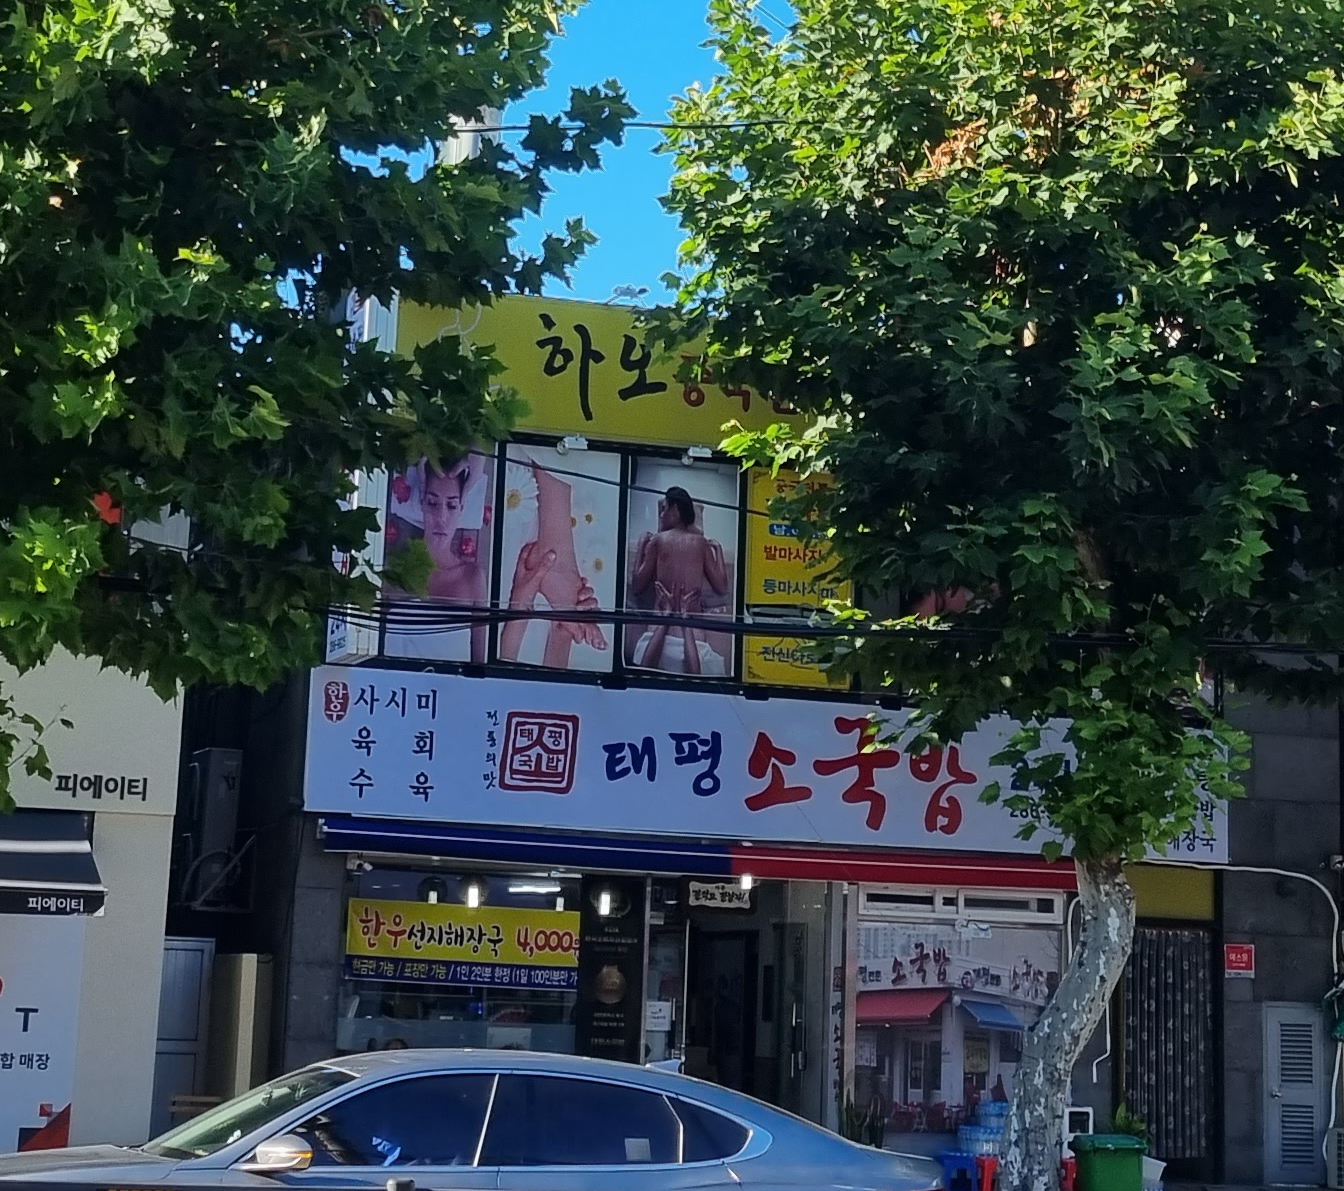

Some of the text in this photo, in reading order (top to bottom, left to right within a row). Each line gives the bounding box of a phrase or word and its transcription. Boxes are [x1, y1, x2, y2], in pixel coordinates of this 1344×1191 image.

[327, 682, 438, 722] 한우 사시미
[55, 773, 149, 802] 피에이티
[603, 730, 722, 797] 태평
[744, 715, 977, 836] 소국밥
[27, 896, 85, 913] 피에이티
[378, 960, 394, 976] 가능
[403, 962, 428, 978] 포장만
[430, 964, 447, 979] 가능
[456, 965, 470, 981] 1인
[471, 966, 492, 982] 2인분
[494, 967, 511, 983] 한정
[19, 1053, 51, 1072] 매장
